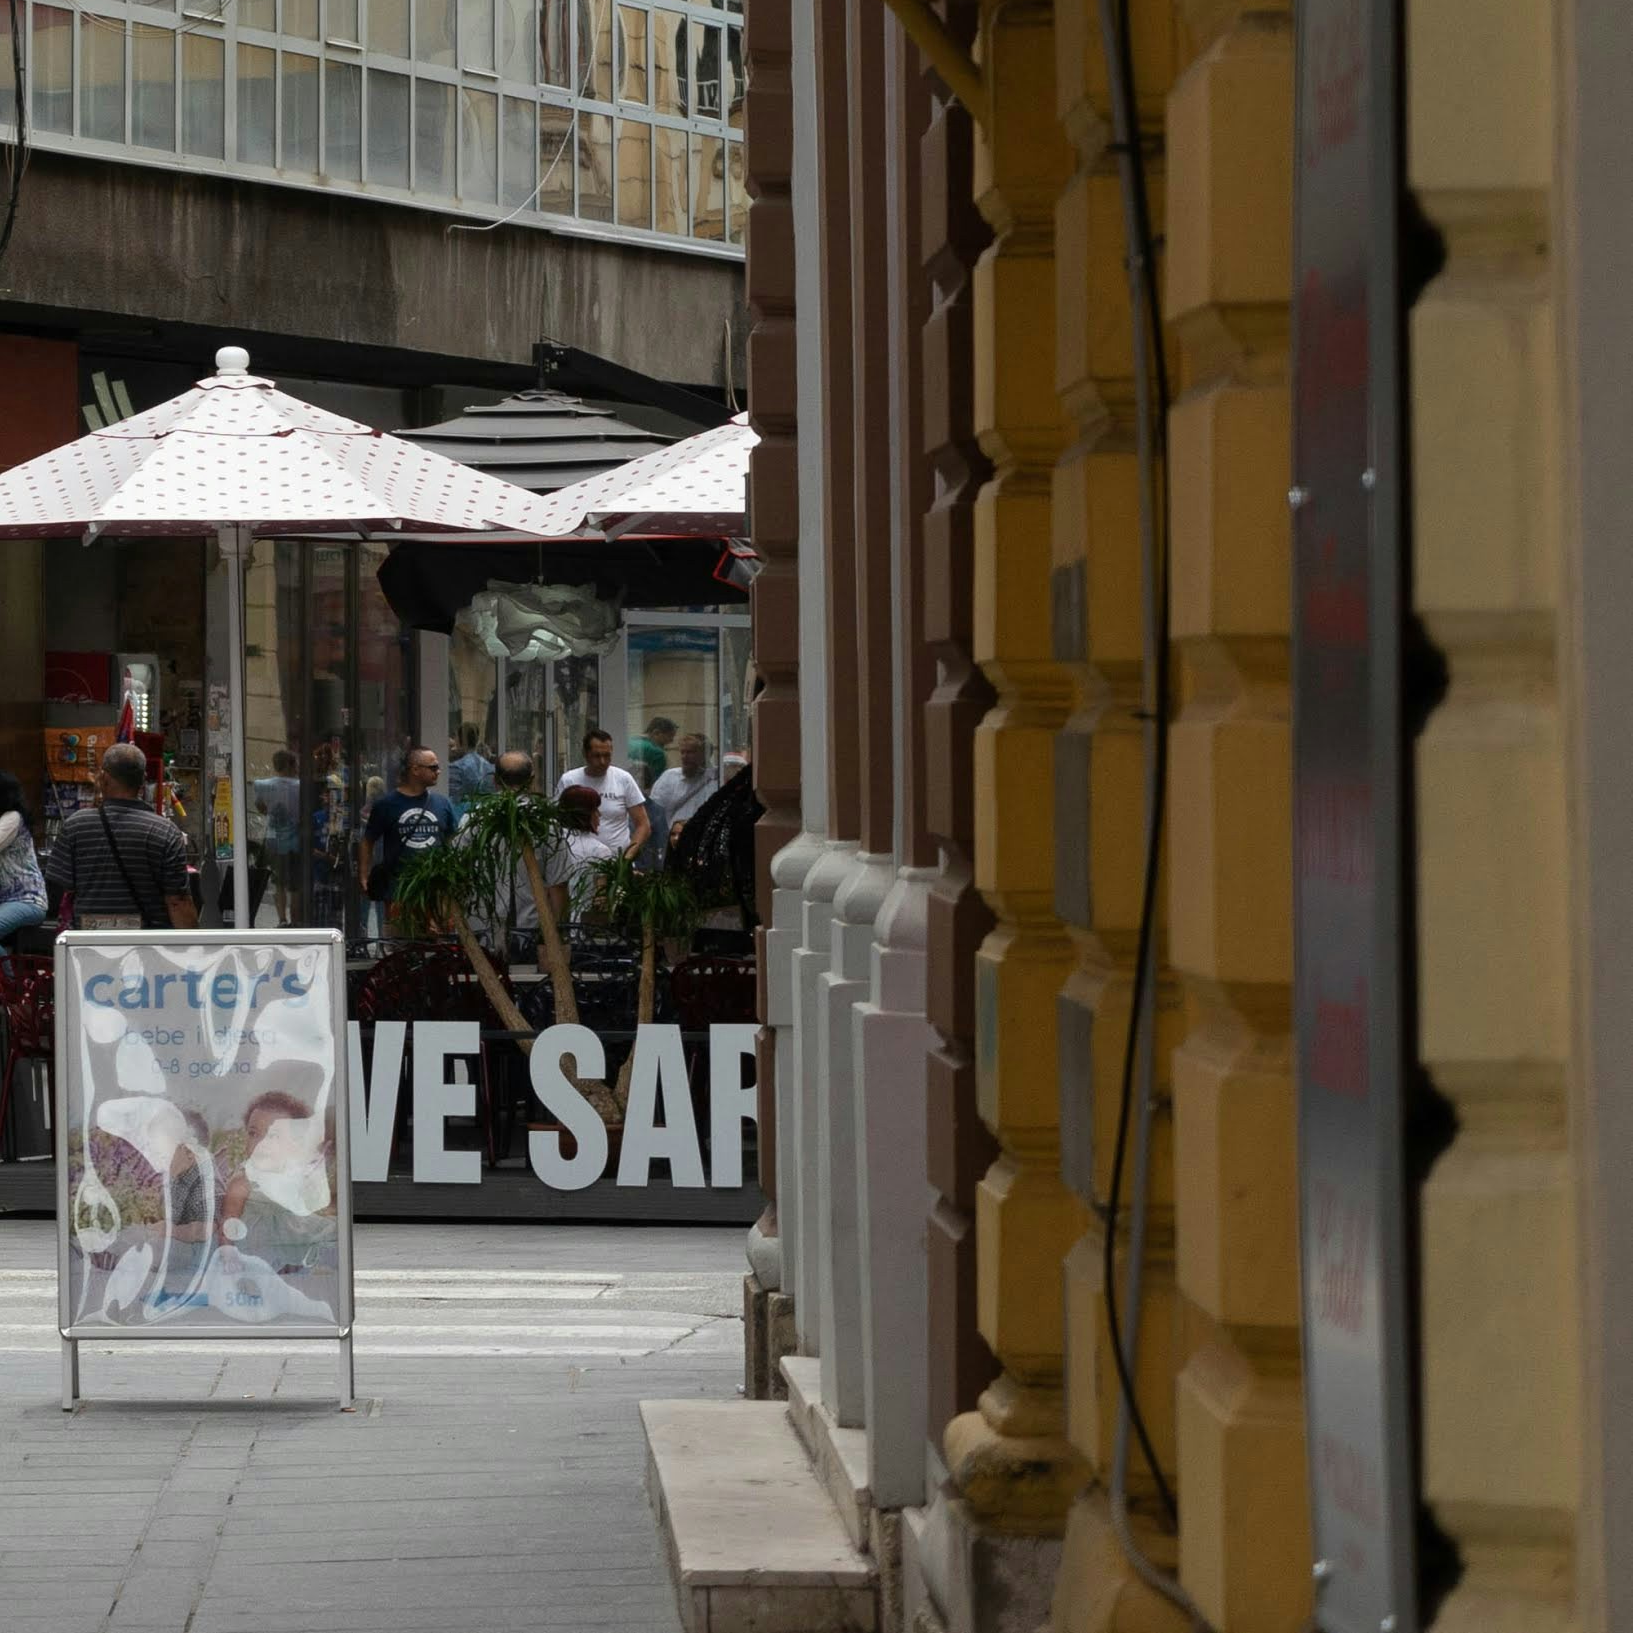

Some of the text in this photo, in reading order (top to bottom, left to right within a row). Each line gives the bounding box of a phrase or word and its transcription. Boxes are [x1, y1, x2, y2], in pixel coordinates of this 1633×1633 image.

[85, 960, 310, 1010] carter's
[347, 1019, 763, 1191] VE SAR
